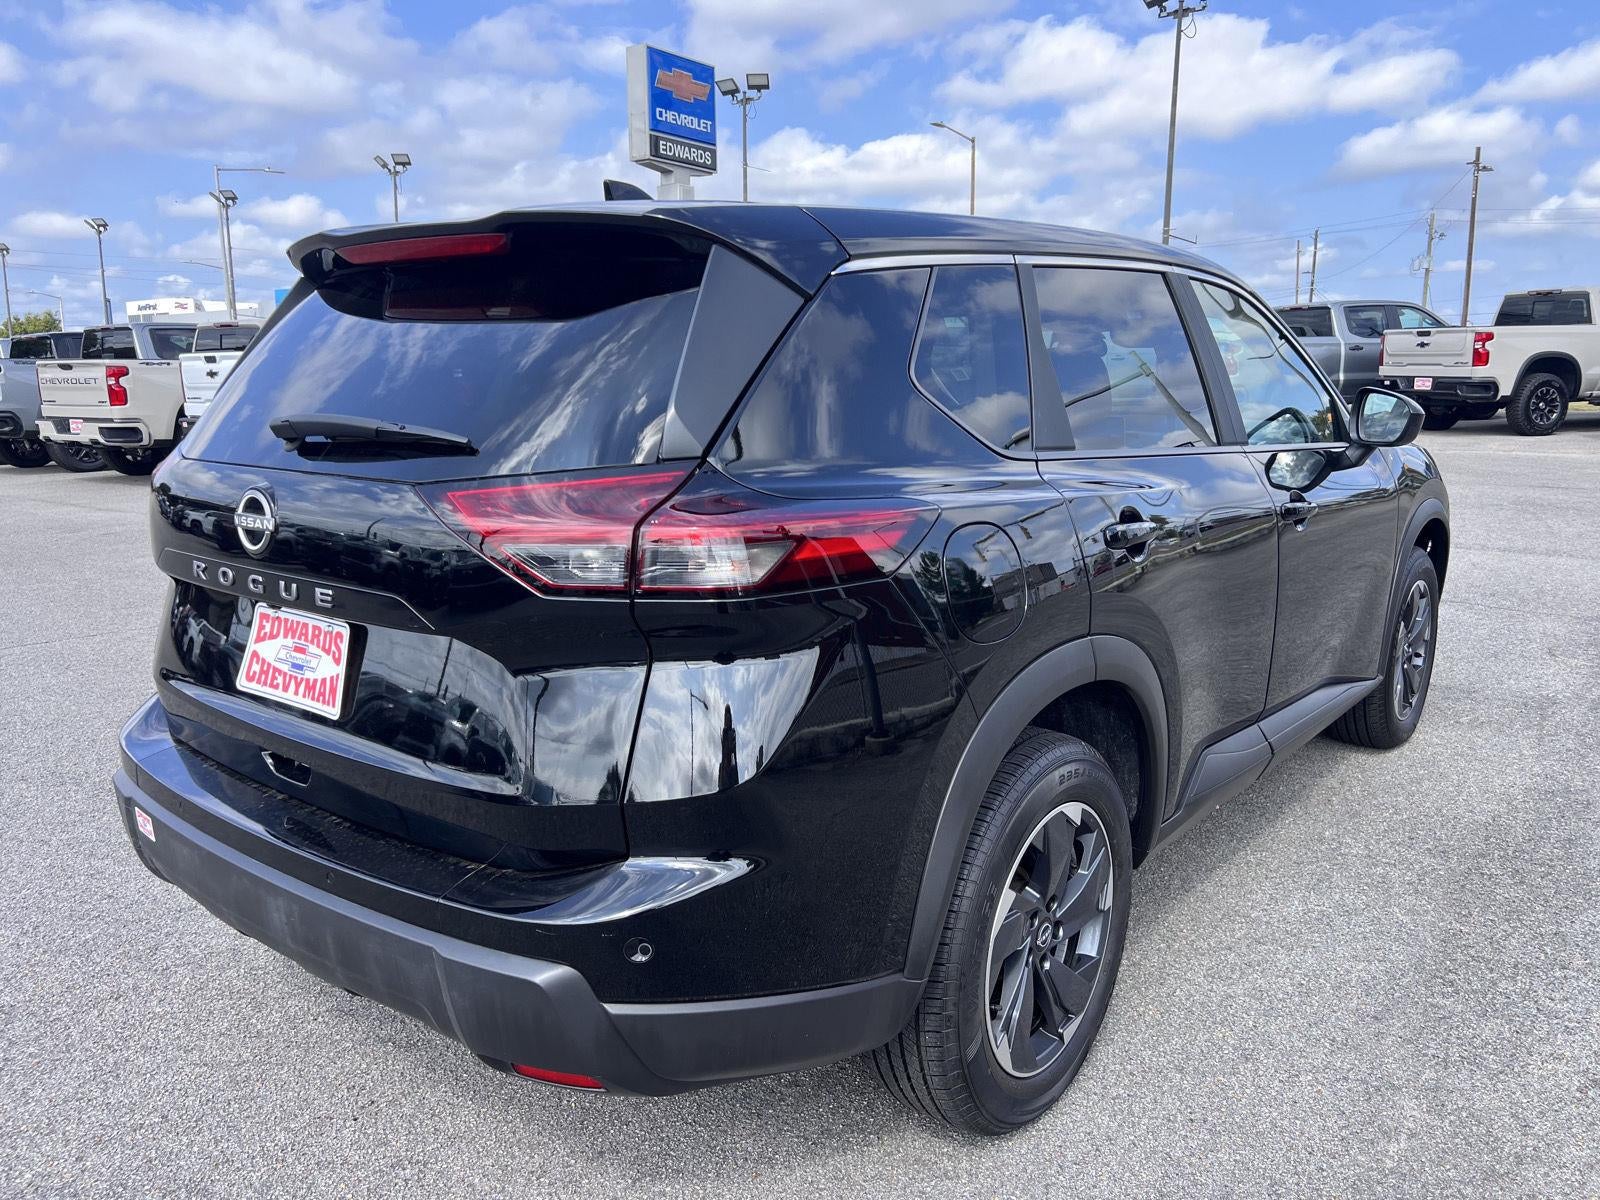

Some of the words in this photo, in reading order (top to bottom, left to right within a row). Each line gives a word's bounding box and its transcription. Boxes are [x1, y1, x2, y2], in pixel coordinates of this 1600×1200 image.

[656, 107, 712, 132] CHEVROLET
[659, 140, 712, 165] EDWARDS
[40, 377, 98, 385] CHEVROLET
[235, 513, 274, 530] NISSAN
[192, 560, 335, 608] ROGUE
[254, 612, 344, 667] EDWARDS
[285, 651, 312, 665] Chevrolet
[245, 650, 340, 709] CHEVYMAN
